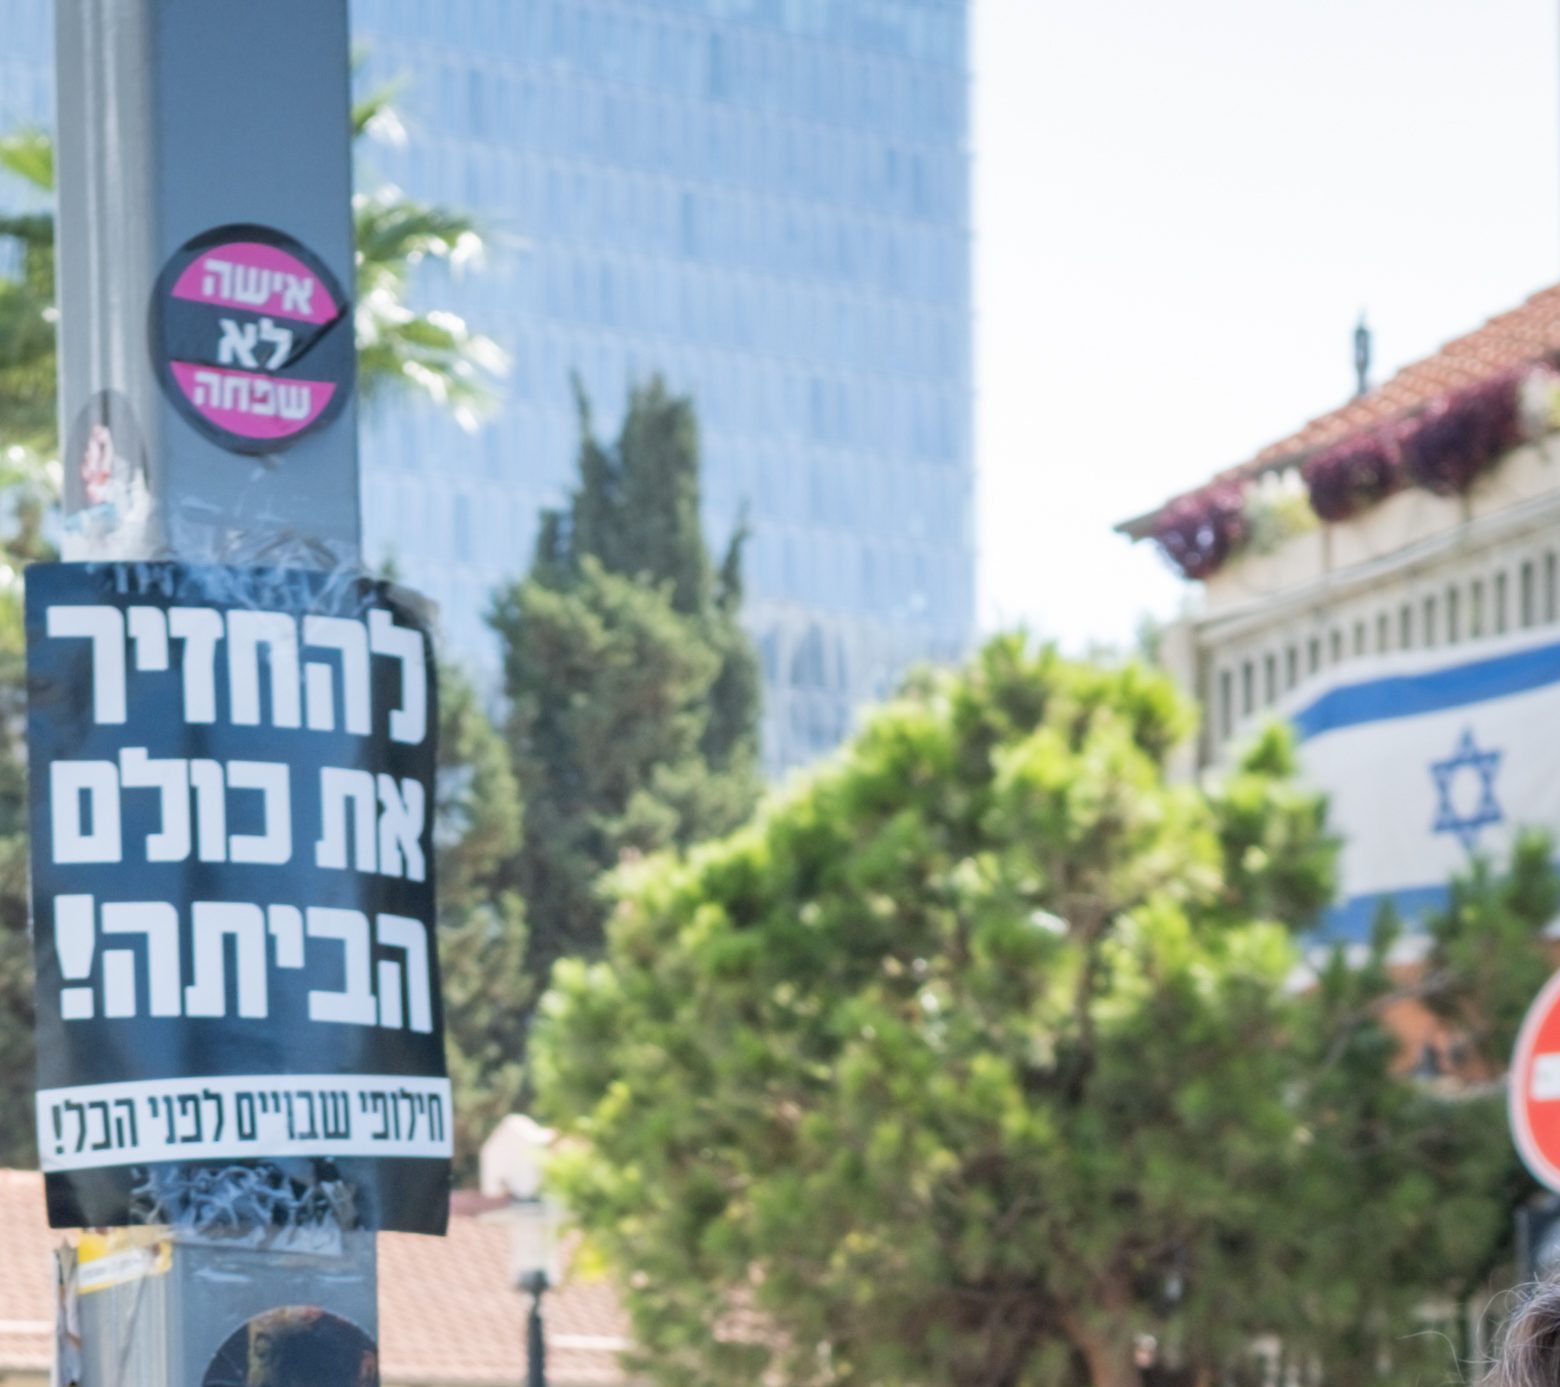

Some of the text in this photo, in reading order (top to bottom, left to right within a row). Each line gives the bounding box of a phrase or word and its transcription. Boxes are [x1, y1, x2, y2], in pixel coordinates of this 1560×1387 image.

[200, 258, 316, 315] אישה
[217, 316, 292, 370] לא
[193, 370, 313, 421] שפחה
[46, 603, 429, 745] להחזיר
[49, 746, 427, 882] את כולם
[52, 893, 434, 1034] הביתה!
[51, 1087, 445, 1156] חילופי שבויים לפני הכל!
